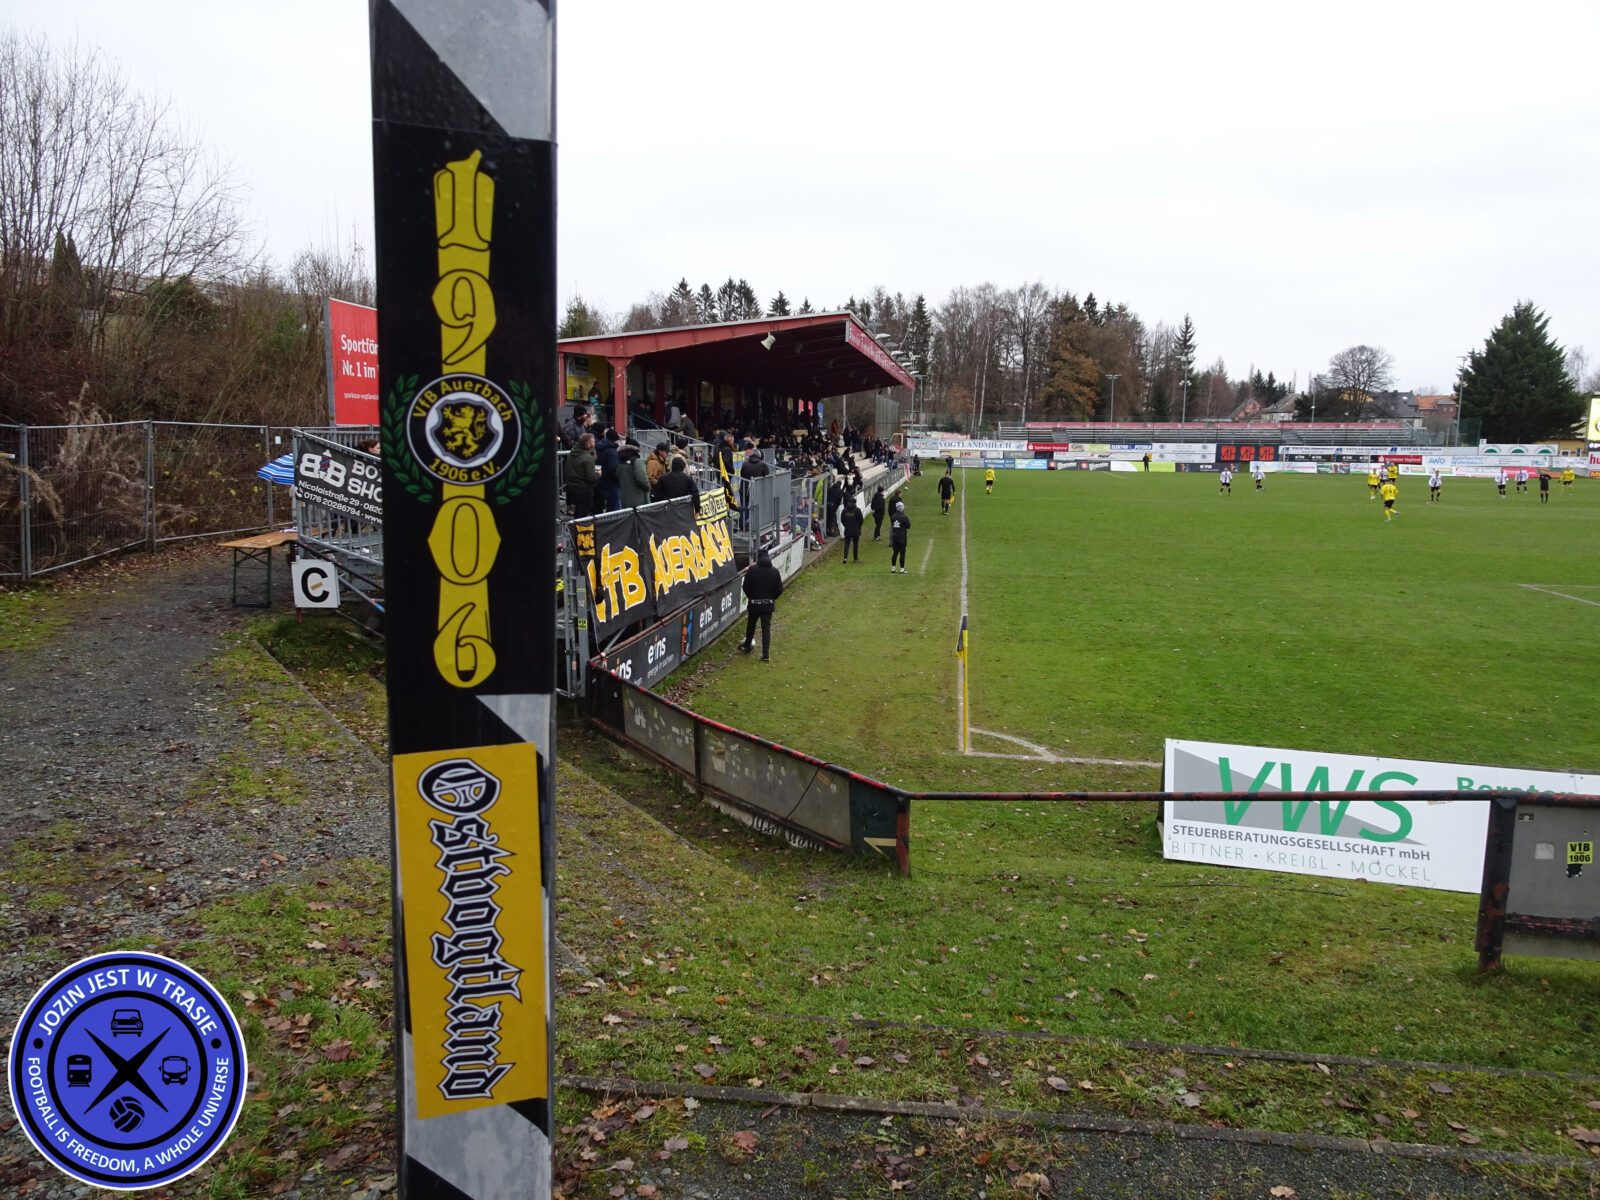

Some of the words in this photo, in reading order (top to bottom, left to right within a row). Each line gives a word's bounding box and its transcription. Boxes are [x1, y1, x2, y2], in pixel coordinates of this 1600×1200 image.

[356, 361, 362, 377] 1
[363, 361, 376, 378] im
[412, 389, 438, 418] VfB
[440, 380, 513, 421] Auerbach
[939, 440, 1012, 449] VOGTLANDMILCH
[429, 458, 468, 481] 1906
[471, 461, 500, 481] e.V.
[298, 480, 349, 502] Nicolaistraße
[349, 498, 360, 506] 29
[304, 491, 322, 503] 0176
[322, 498, 361, 516] 20286794
[649, 520, 735, 600] AUERBACH
[301, 567, 329, 603] C
[721, 590, 732, 612] eins
[699, 602, 713, 628] eins
[647, 634, 667, 665] eins
[1218, 756, 1419, 843] VWS
[1171, 840, 1244, 860] BITTNER
[1266, 851, 1328, 870] KREIßL
[1173, 825, 1395, 857] STEUERBERATUNGSGESELLSCHAFT
[1399, 849, 1430, 861] mbH
[1569, 854, 1591, 862] 1906
